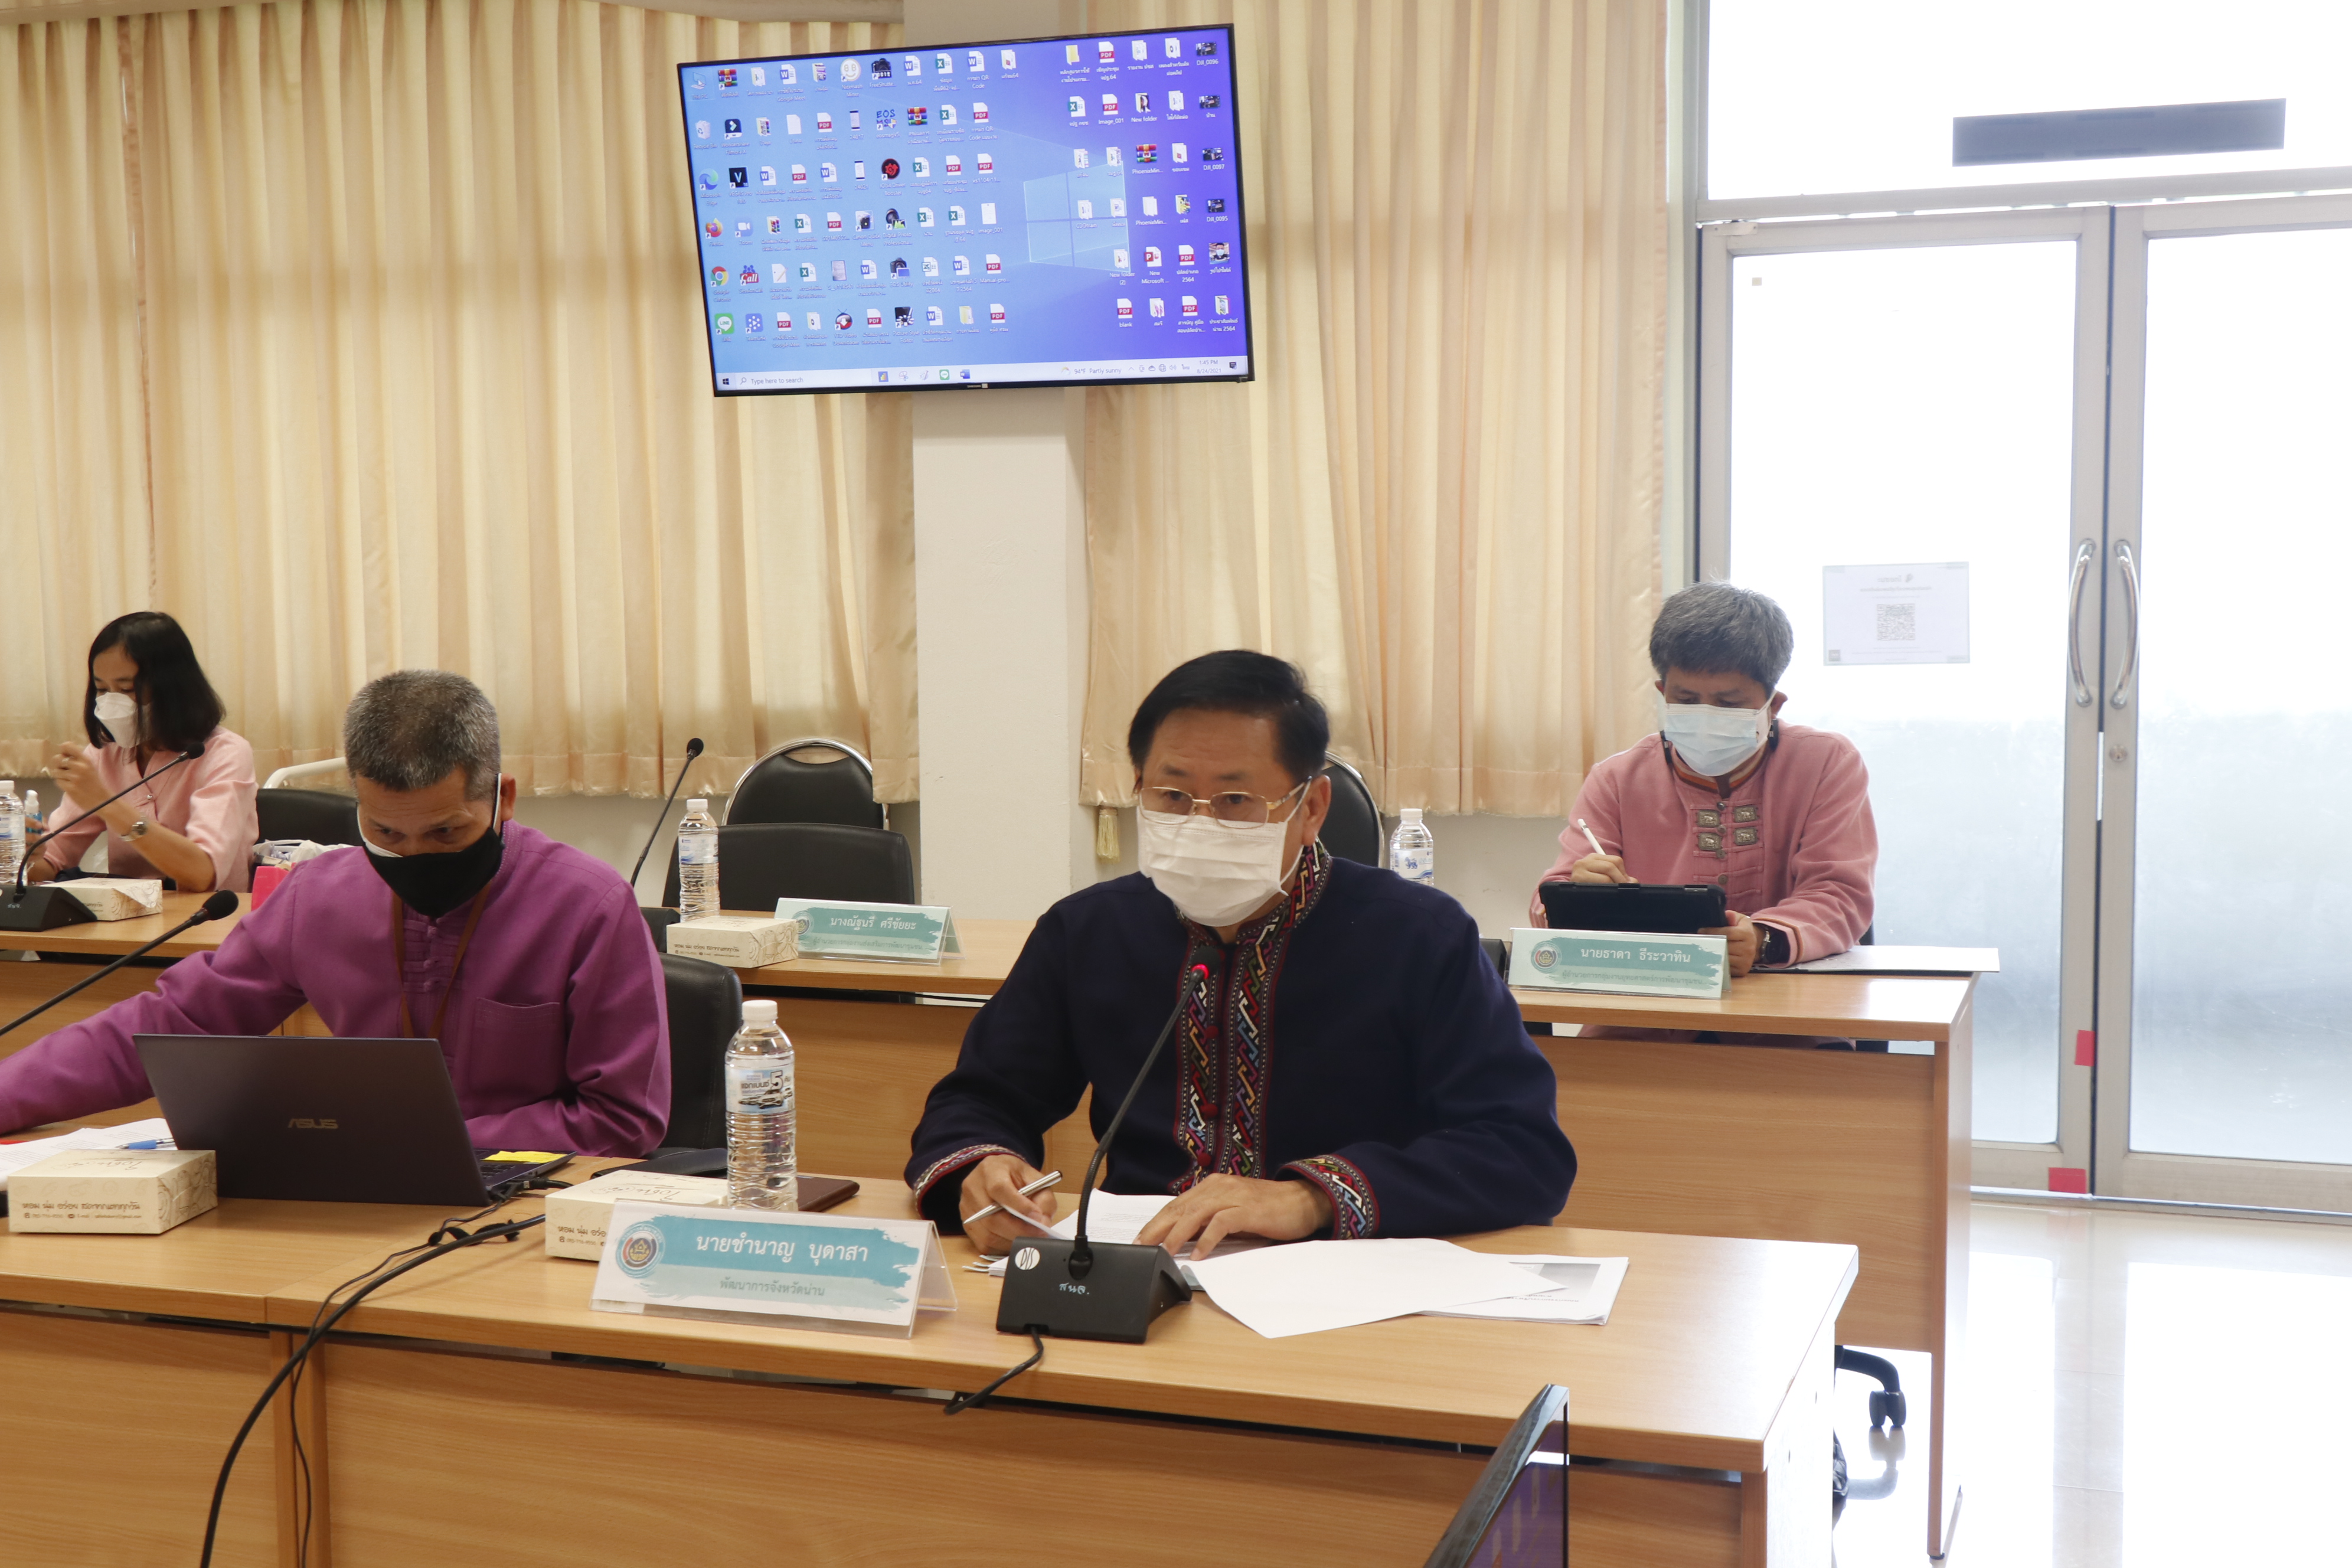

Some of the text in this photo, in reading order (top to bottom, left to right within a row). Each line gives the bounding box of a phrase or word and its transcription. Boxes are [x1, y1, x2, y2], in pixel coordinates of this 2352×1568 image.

[877, 109, 896, 119] EOS
[880, 917, 916, 930] ศรีชัยยะ
[1580, 947, 1691, 963] นายธาดา ธีระวาทิน
[770, 1070, 783, 1090] 5
[288, 1118, 338, 1129] ASUS
[43, 1200, 54, 1211] นุ่ม
[57, 1200, 79, 1209] อร่อย
[576, 1225, 588, 1237] นุ่ม
[591, 1227, 606, 1237] อร่อ
[697, 1232, 795, 1263] นายชำนาญ
[809, 1241, 868, 1266] บุดาสา
[719, 1276, 825, 1296] พัฒนาการจังหวัดน่าน
